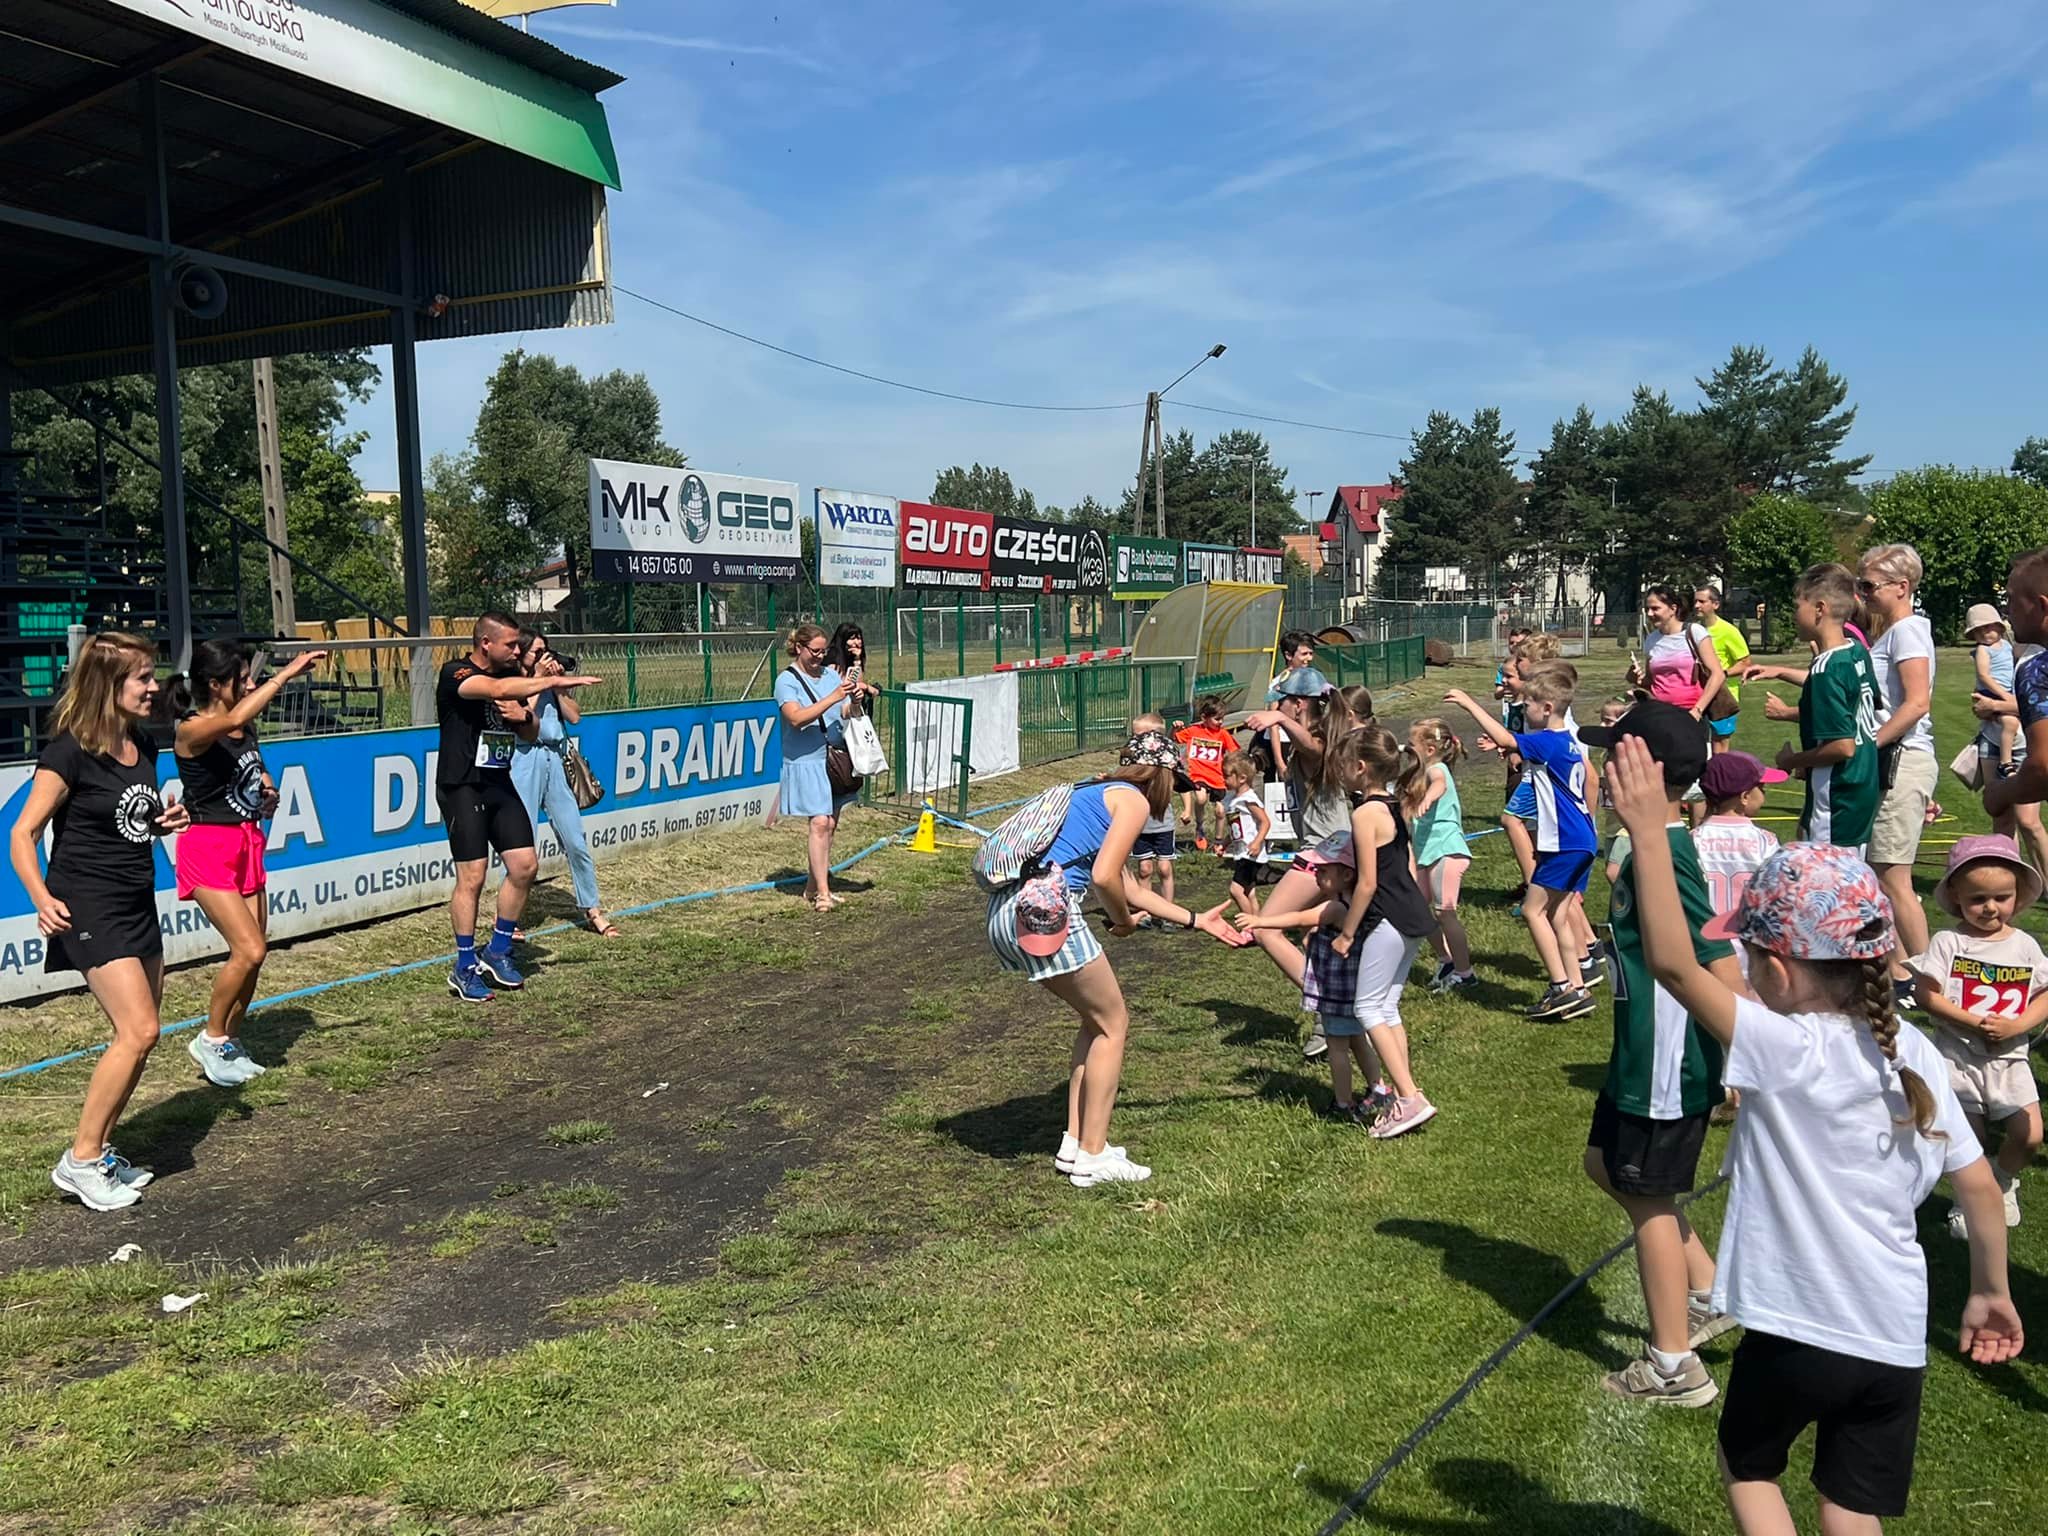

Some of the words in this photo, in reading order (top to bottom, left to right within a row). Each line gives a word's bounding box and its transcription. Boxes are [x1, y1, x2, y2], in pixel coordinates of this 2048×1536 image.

[601, 479, 670, 522] MK
[717, 491, 793, 531] GEO
[822, 501, 895, 531] WARTA
[603, 523, 672, 537] USŁUGI
[994, 527, 1077, 566] CZĘŚCI
[1131, 548, 1145, 565] Bank
[628, 556, 639, 574] 14
[642, 557, 661, 575] 657
[663, 557, 677, 575] 05
[679, 558, 692, 575] 00
[615, 716, 776, 797] BRAMY
[1198, 747, 1217, 761] 29
[315, 882, 348, 905] UL.
[355, 861, 455, 898] OLEŚNICK
[592, 827, 616, 848] 642
[620, 823, 637, 842] 00
[640, 820, 659, 839] 55,
[664, 817, 693, 834] kom.
[696, 808, 716, 827] 697
[719, 804, 739, 822] 507
[743, 799, 762, 818] 198
[1701, 838, 1758, 853] STEELERS
[1953, 960, 1981, 974] BIEG
[1996, 968, 2017, 982] 100
[1968, 985, 2023, 1020] 22
